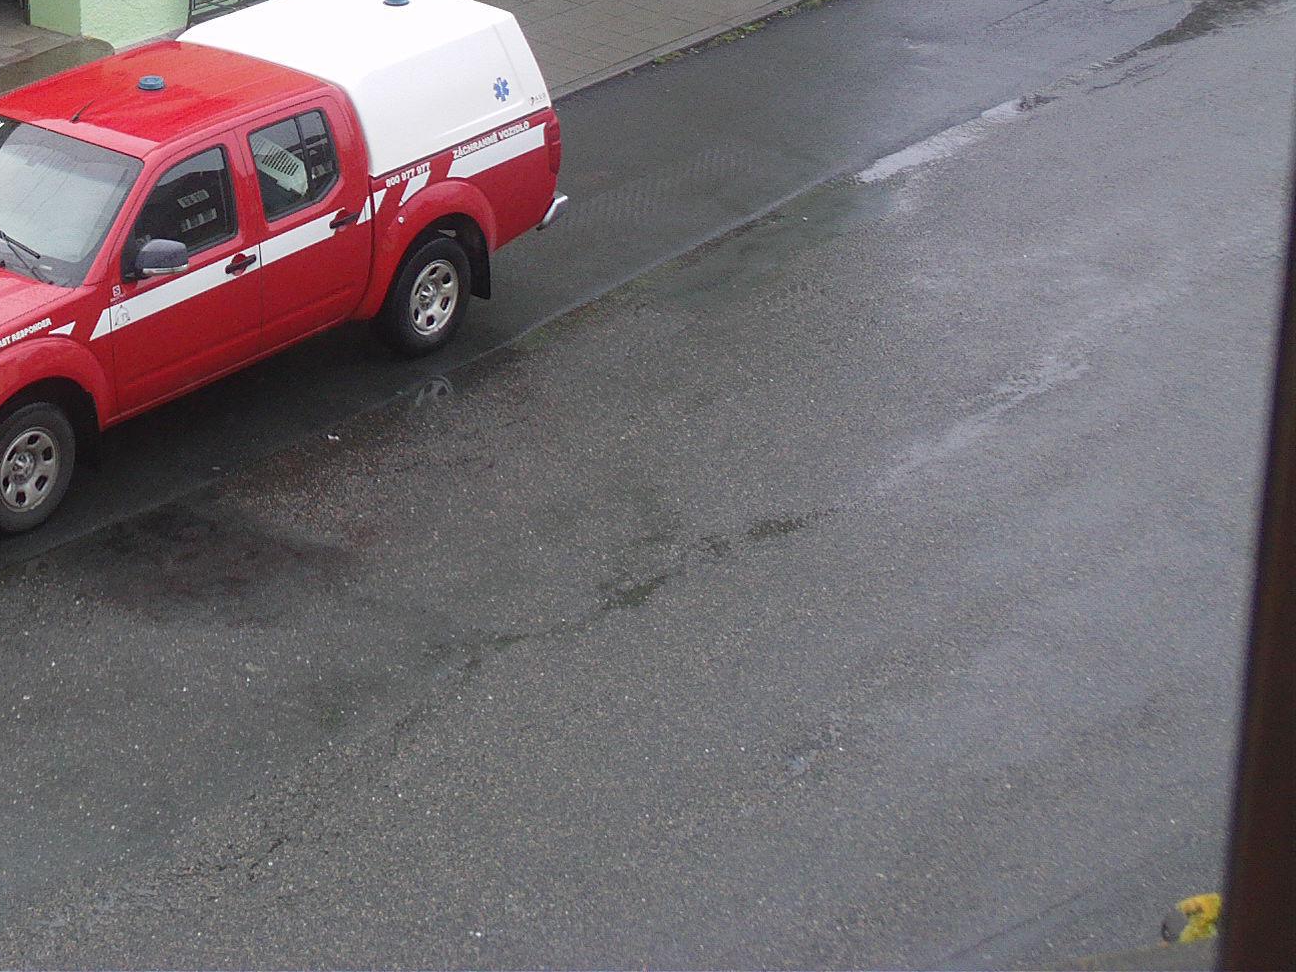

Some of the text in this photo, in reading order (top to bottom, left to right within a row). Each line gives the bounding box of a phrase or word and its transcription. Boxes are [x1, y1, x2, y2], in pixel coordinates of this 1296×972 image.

[385, 161, 431, 188] 800 977 977
[11, 317, 52, 342] RESPONDER
